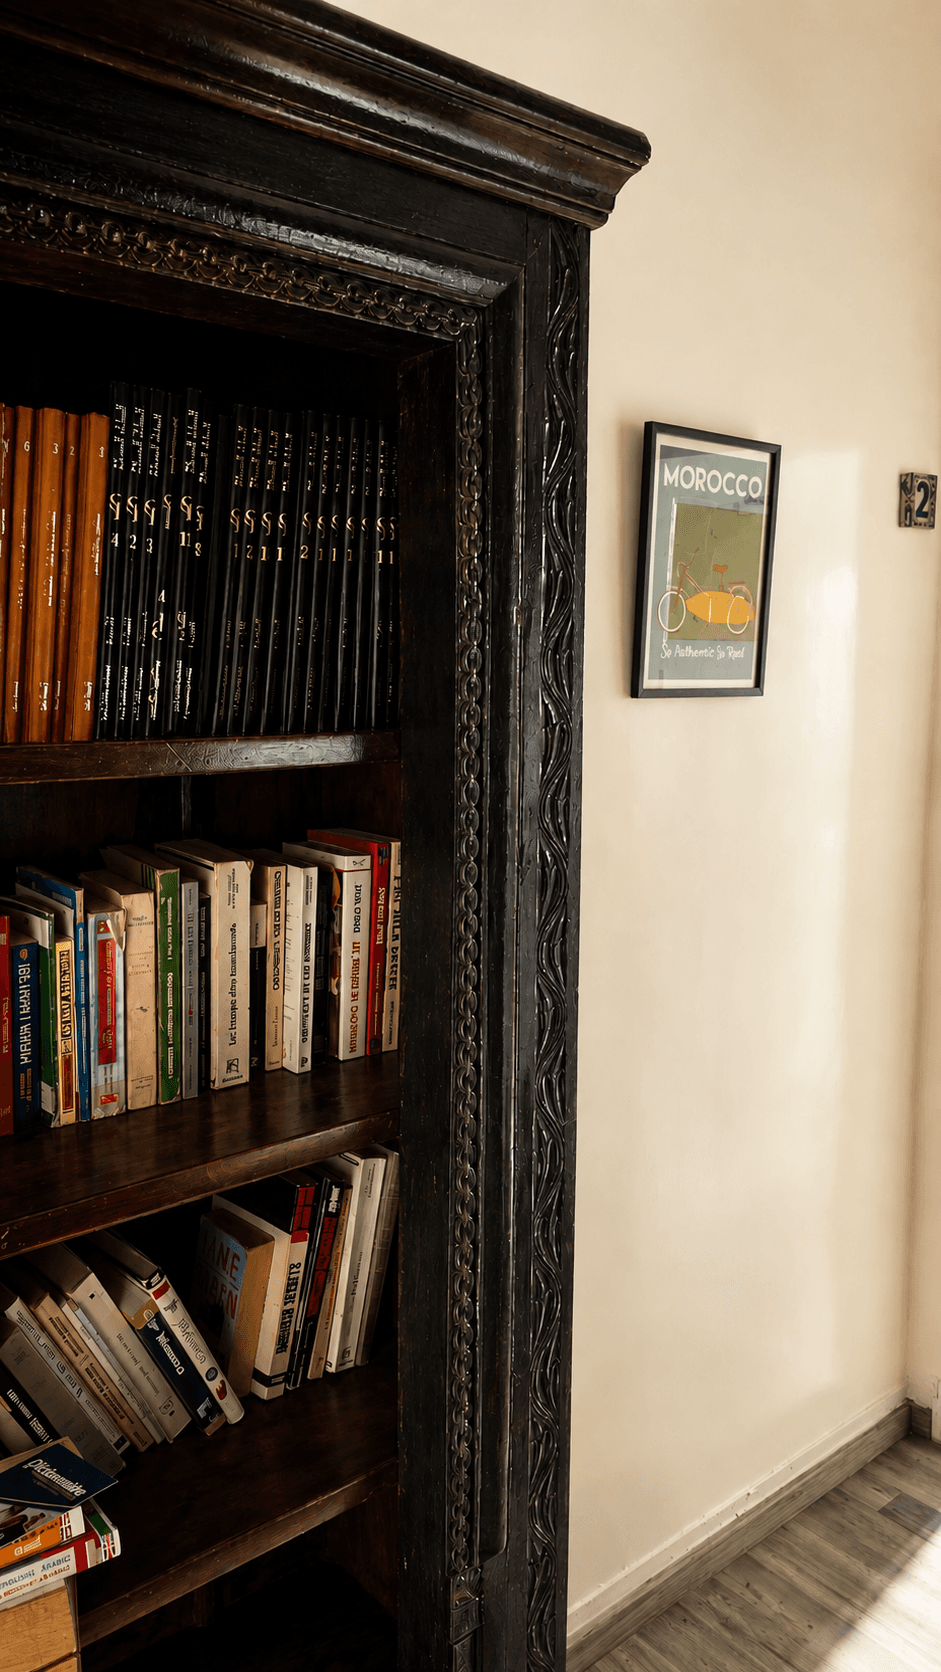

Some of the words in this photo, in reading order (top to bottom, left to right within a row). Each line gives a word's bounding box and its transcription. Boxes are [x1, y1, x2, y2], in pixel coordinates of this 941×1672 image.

[663, 463, 763, 499] MOROCCO
[916, 481, 930, 518] 2
[660, 641, 672, 659] So
